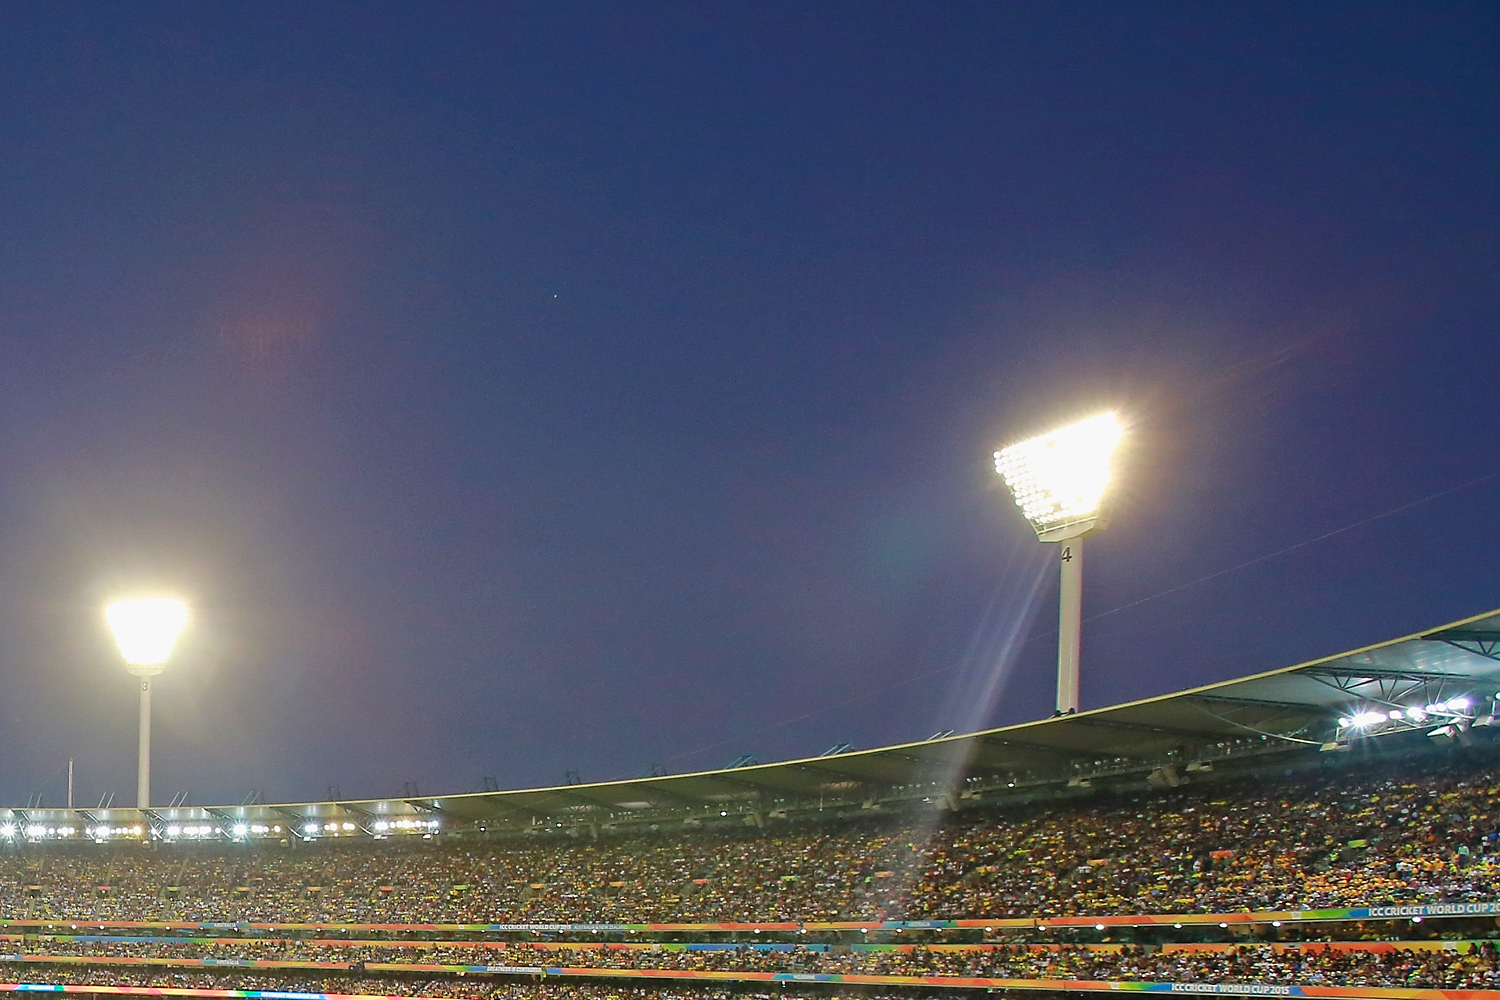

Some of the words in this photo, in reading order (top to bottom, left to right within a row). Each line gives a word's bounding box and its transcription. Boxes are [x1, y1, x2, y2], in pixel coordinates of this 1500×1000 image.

[1369, 908, 1384, 916] ICC
[1385, 907, 1424, 915] CRICKET
[1427, 904, 1465, 914] WORLD
[1467, 903, 1488, 913] CUP
[1185, 984, 1217, 992] CRICKET
[1219, 985, 1249, 993] WORLD
